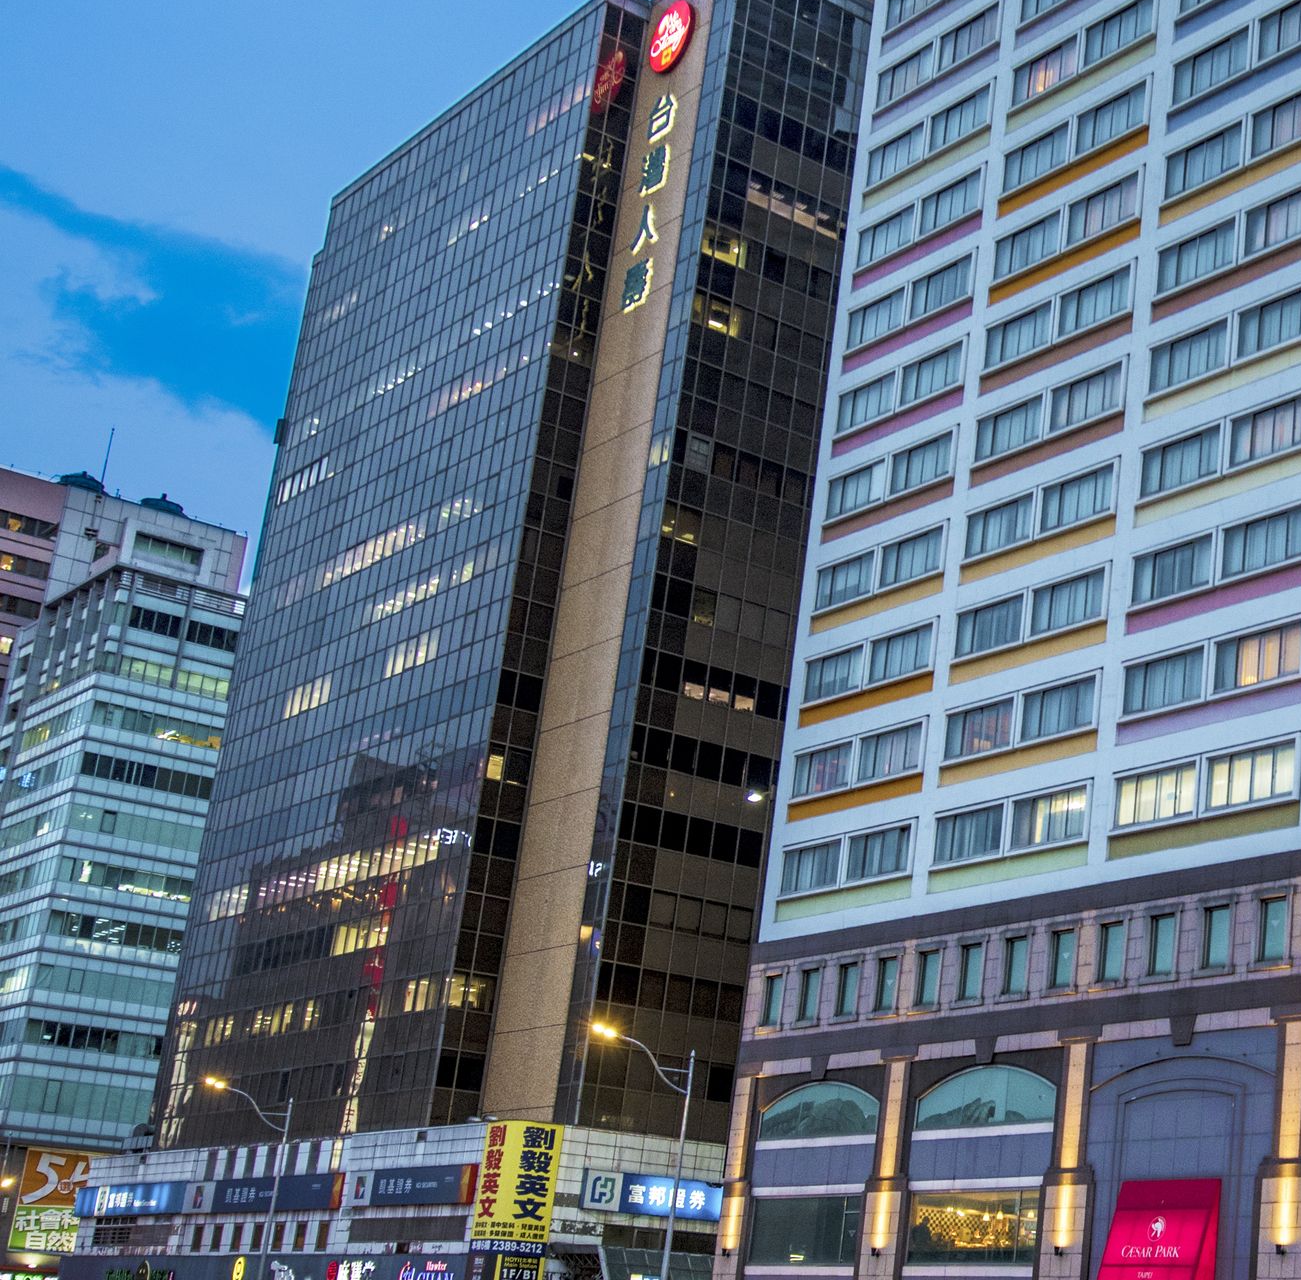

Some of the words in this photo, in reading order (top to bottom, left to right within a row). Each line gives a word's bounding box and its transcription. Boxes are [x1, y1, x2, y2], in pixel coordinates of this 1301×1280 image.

[477, 1125, 507, 1218] 劉毅英文
[512, 1126, 556, 1221] 劉毅英文
[492, 1241, 543, 1253] 2389-5212
[1154, 1245, 1181, 1258] PARK
[426, 1261, 448, 1271] Hawker
[502, 1268, 537, 1280] 1F/B1
